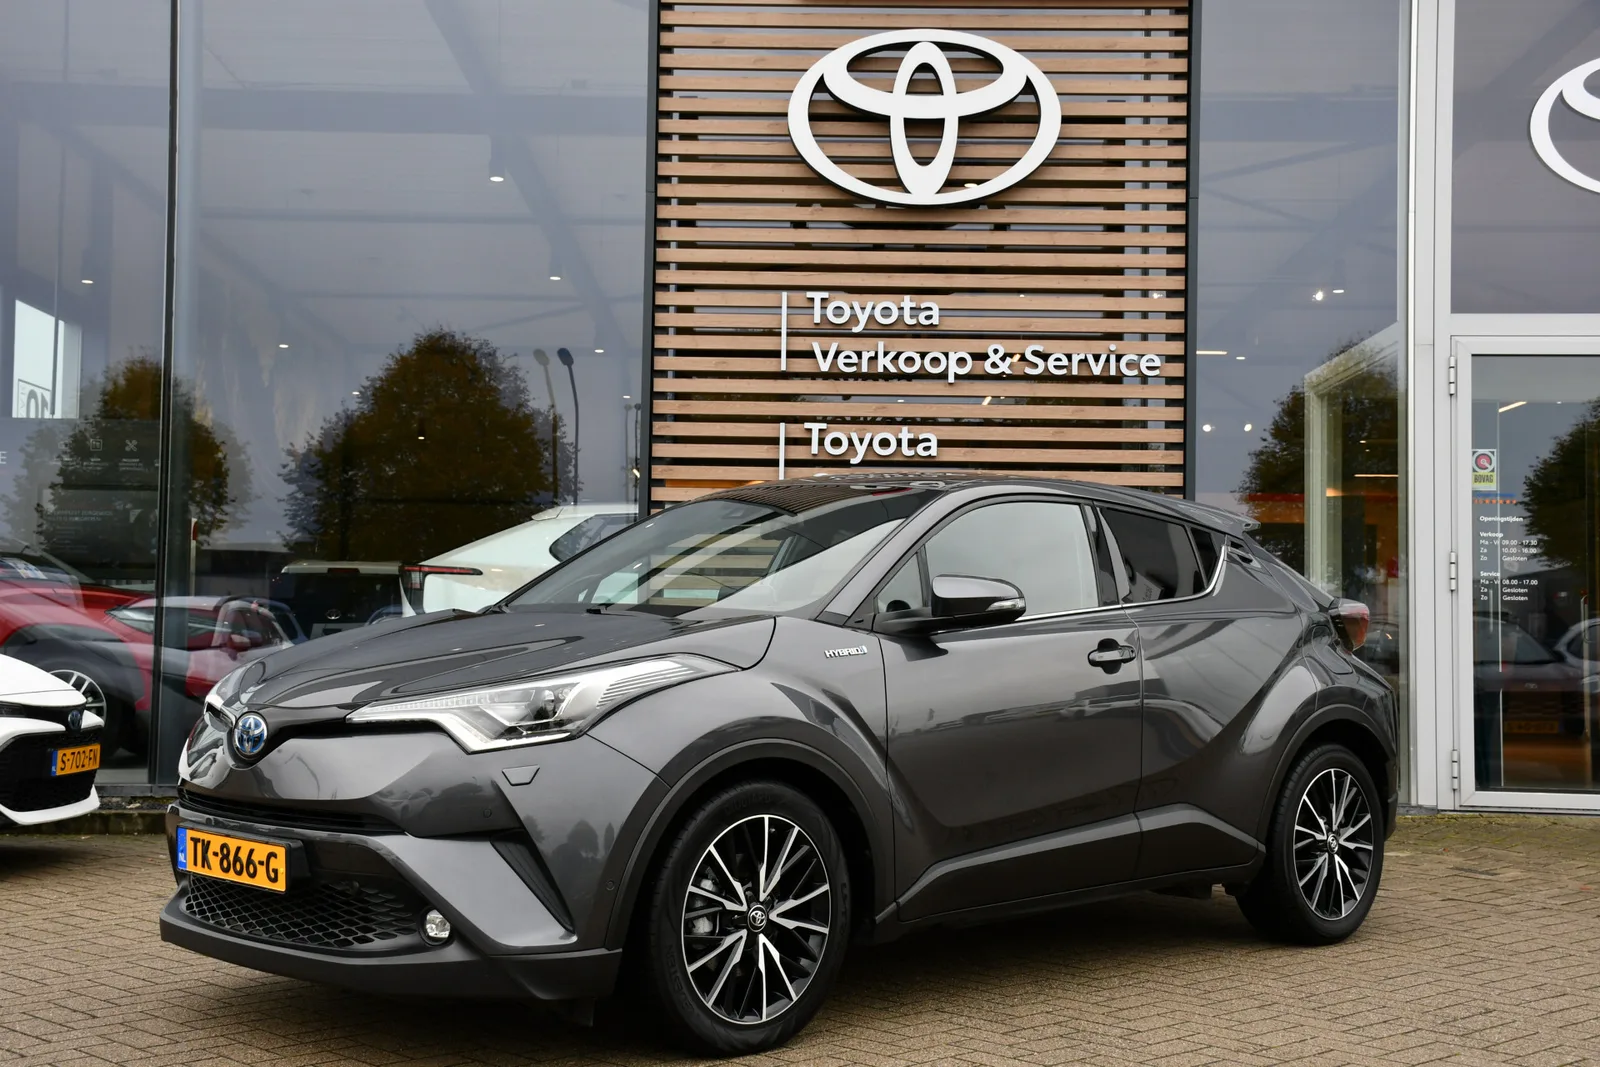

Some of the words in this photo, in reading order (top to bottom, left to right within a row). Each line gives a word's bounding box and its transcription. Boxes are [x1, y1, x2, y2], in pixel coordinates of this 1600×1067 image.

[806, 291, 940, 333] Toyota
[811, 341, 974, 384] Verkoop
[984, 343, 1014, 375] &
[1024, 343, 1162, 377] Service
[803, 422, 938, 464] Toyota
[1474, 474, 1494, 484] BOVAG
[824, 646, 863, 658] HYBRID
[60, 748, 98, 771] S-702-FN
[190, 836, 279, 884] TK-866-G
